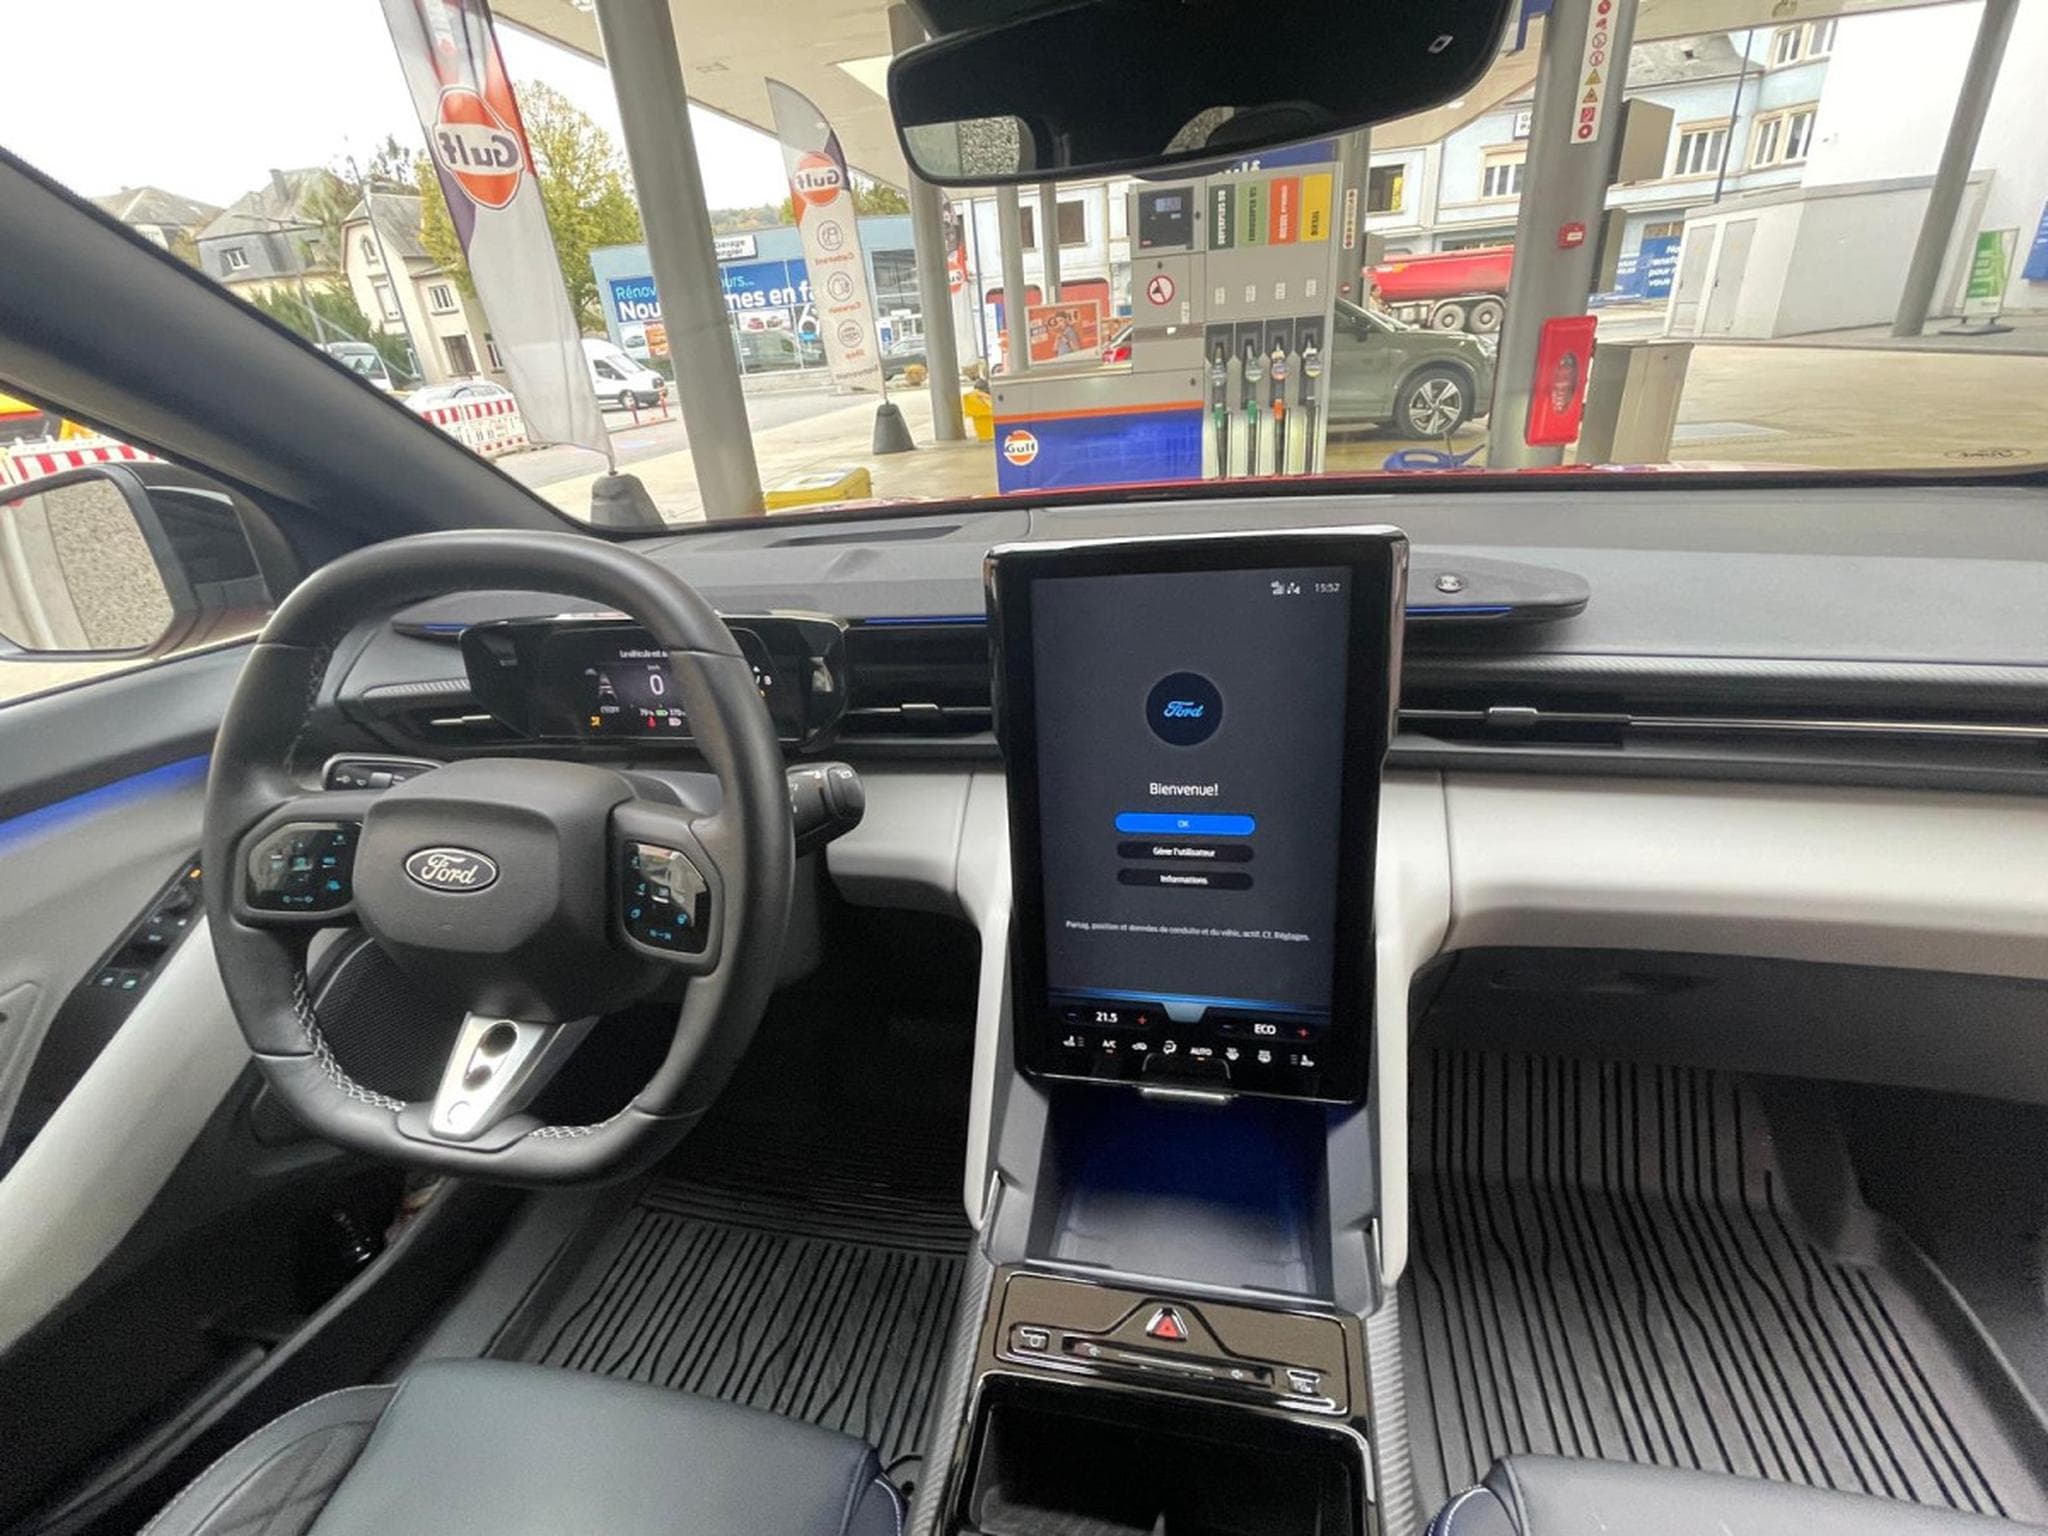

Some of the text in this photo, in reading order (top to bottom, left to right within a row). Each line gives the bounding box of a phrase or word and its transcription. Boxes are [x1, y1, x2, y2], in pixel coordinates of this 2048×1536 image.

[616, 285, 656, 300] Rénov
[618, 301, 662, 320] Nou
[769, 287, 796, 304] en
[1006, 442, 1036, 453] Gulf
[650, 674, 664, 695] 0
[1164, 701, 1204, 718] Ford
[1149, 782, 1219, 796] Bienvenue!
[1178, 820, 1190, 828] OK
[420, 852, 479, 885] Ford
[1096, 1011, 1118, 1023] 21.5
[1254, 1023, 1277, 1035] ECO
